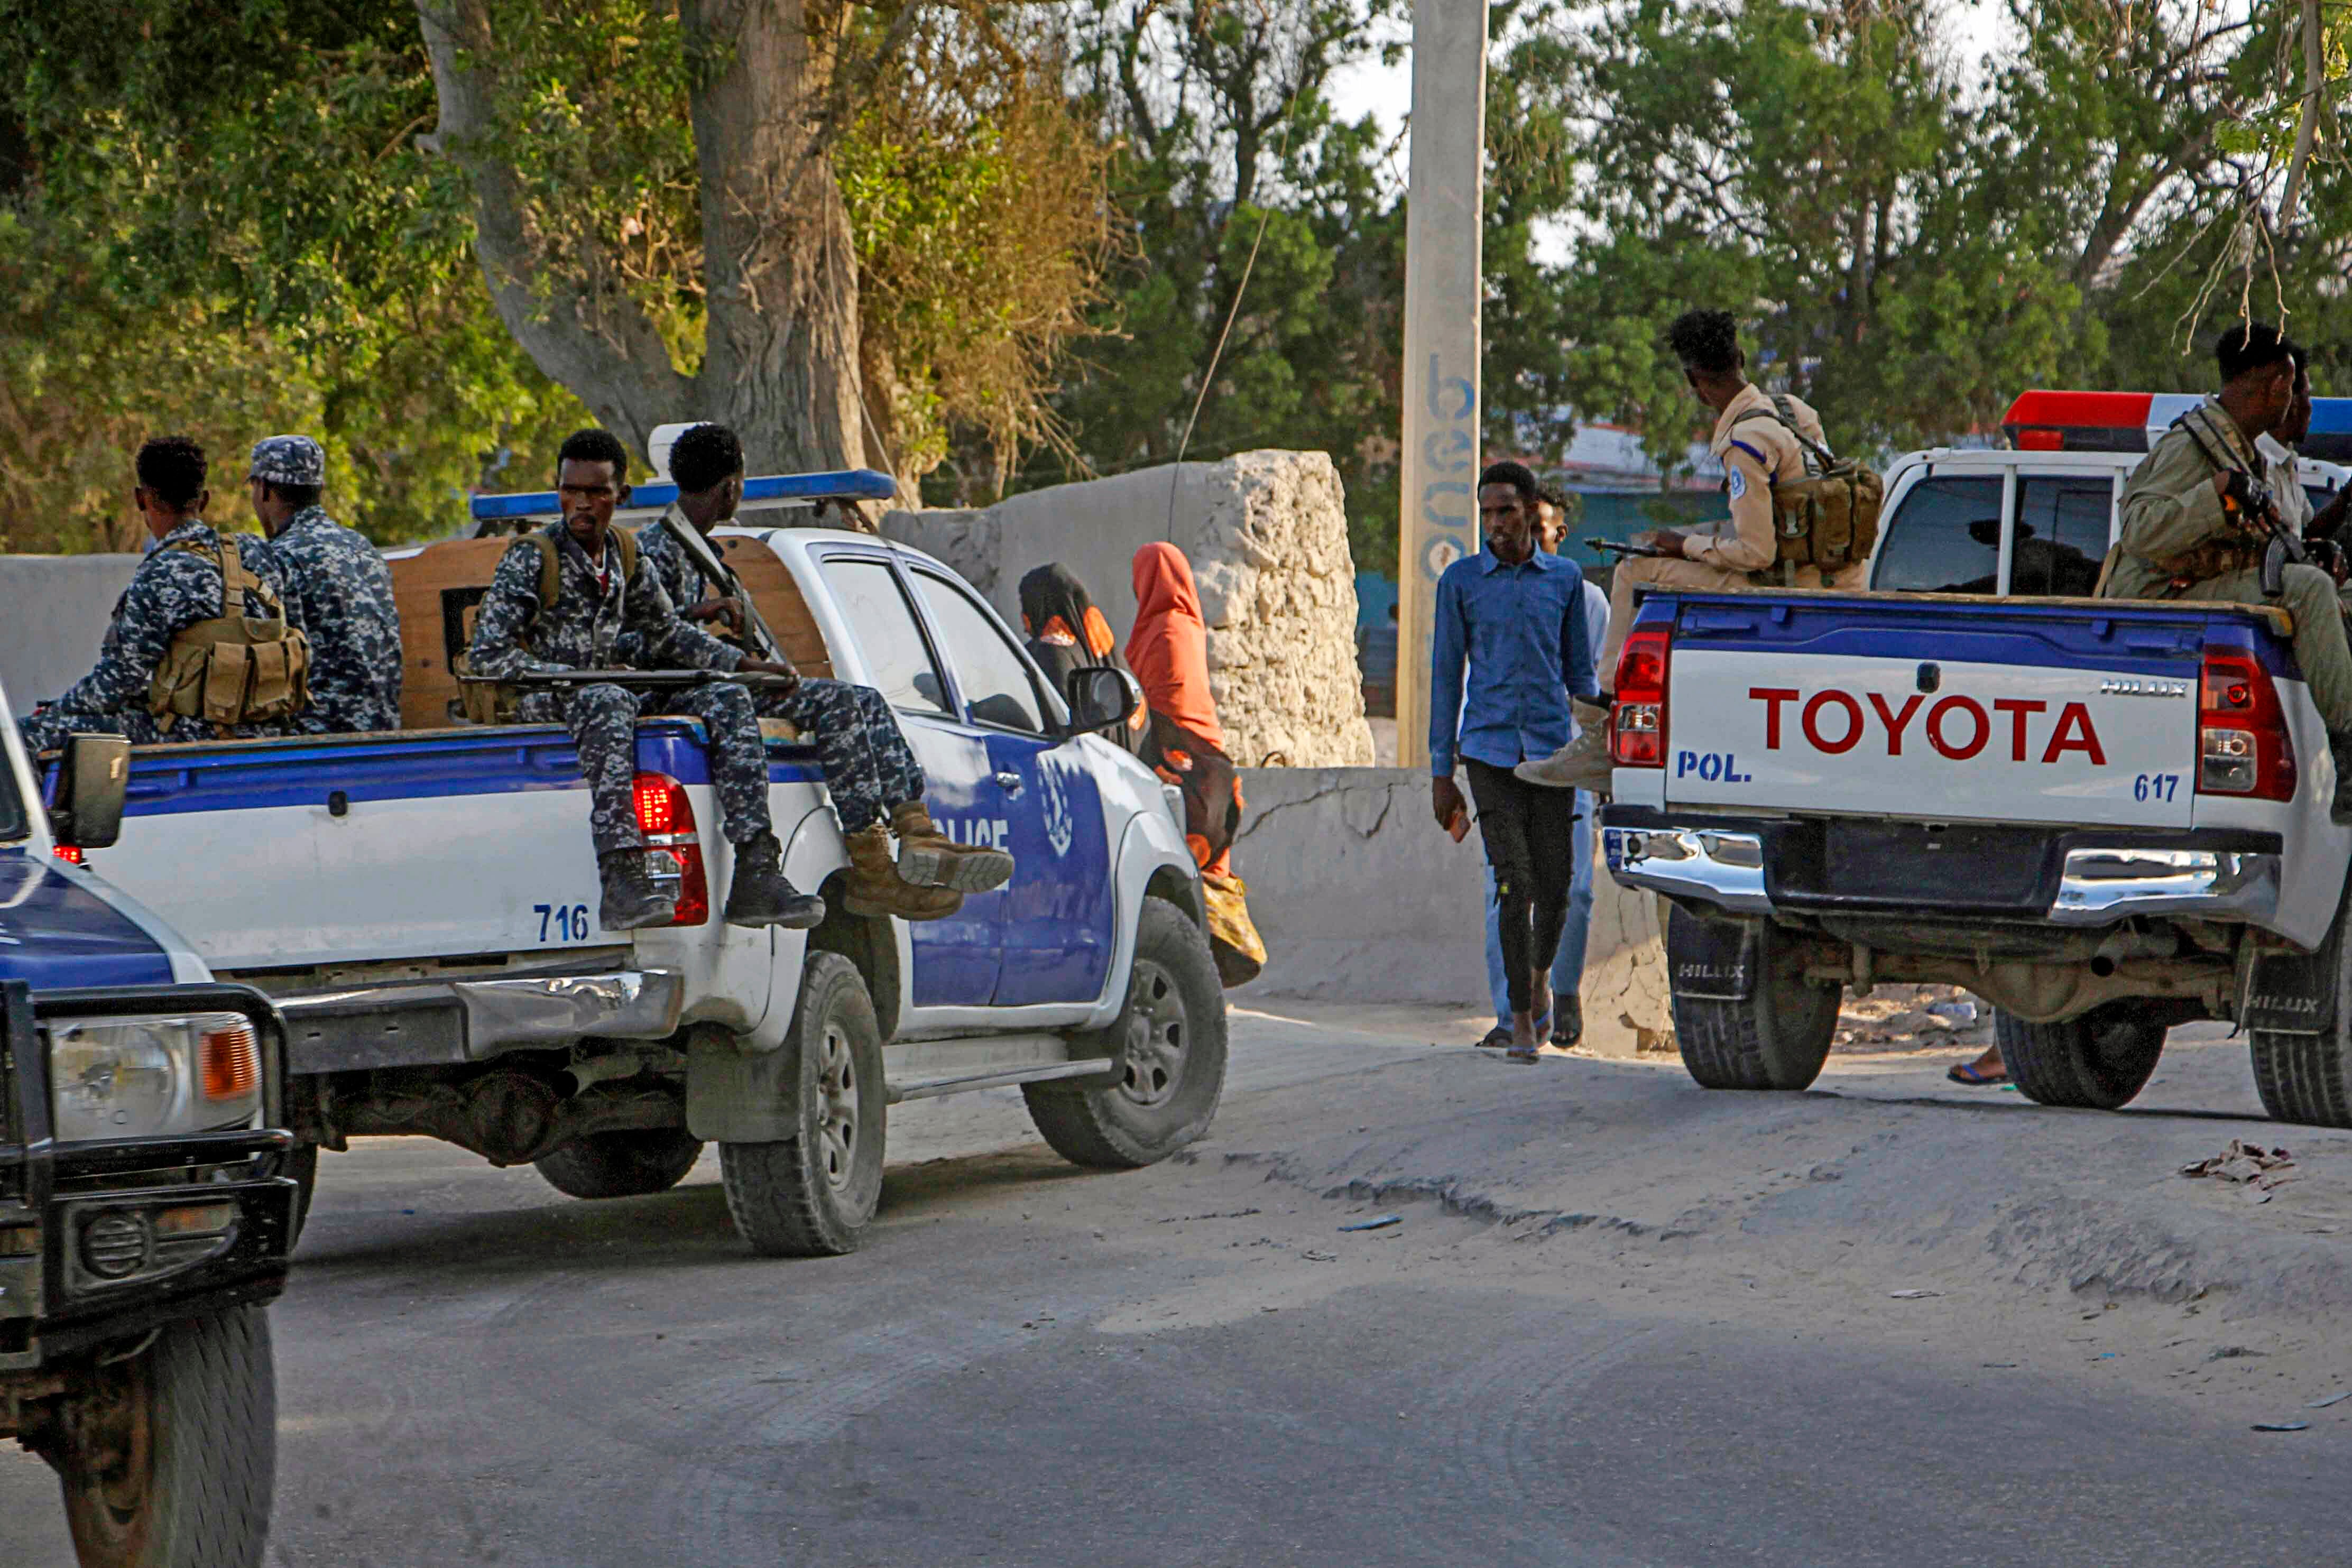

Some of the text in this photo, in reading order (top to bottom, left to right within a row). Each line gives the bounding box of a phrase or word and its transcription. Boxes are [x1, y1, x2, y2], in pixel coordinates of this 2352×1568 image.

[2101, 678, 2188, 697] HILUX
[1749, 687, 2107, 765] TOYOTA
[1677, 751, 1751, 782] POL.
[2134, 773, 2179, 803] 617
[533, 904, 588, 942] 716
